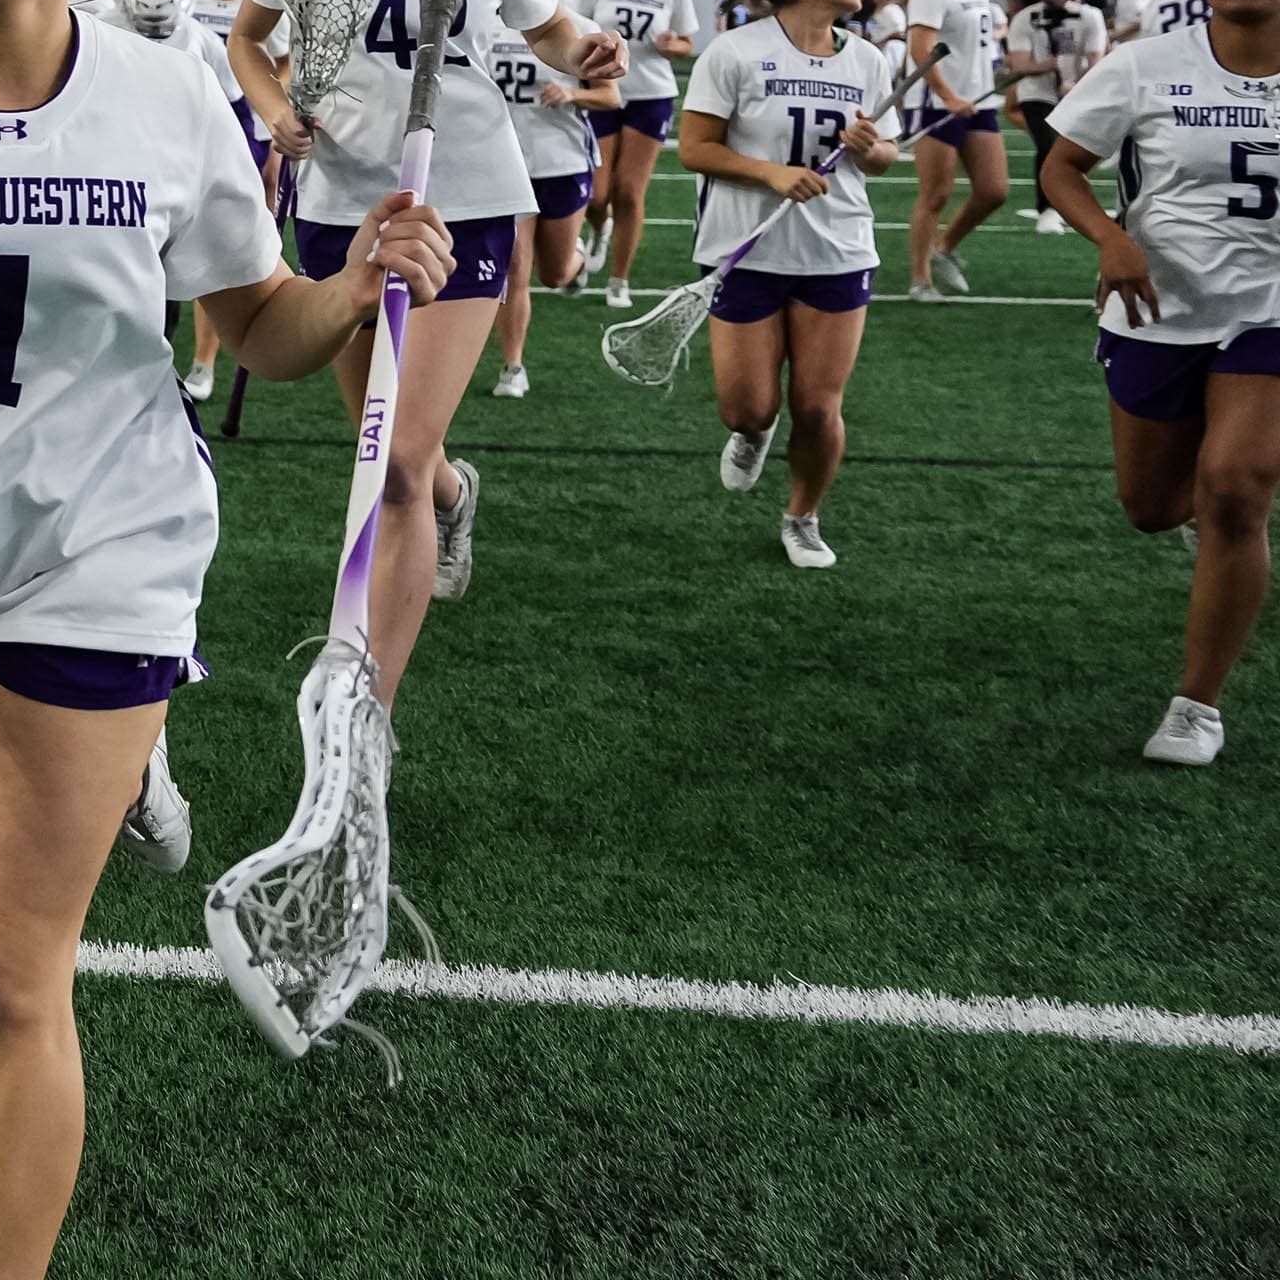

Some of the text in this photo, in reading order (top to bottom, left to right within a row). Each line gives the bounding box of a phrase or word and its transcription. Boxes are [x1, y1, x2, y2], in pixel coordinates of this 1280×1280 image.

[616, 8, 654, 40] 37
[495, 61, 536, 103] 22
[765, 78, 864, 105] NORTHWESTERN
[787, 107, 846, 173] 13
[1228, 141, 1279, 220] 5
[359, 395, 386, 462] GAIT
